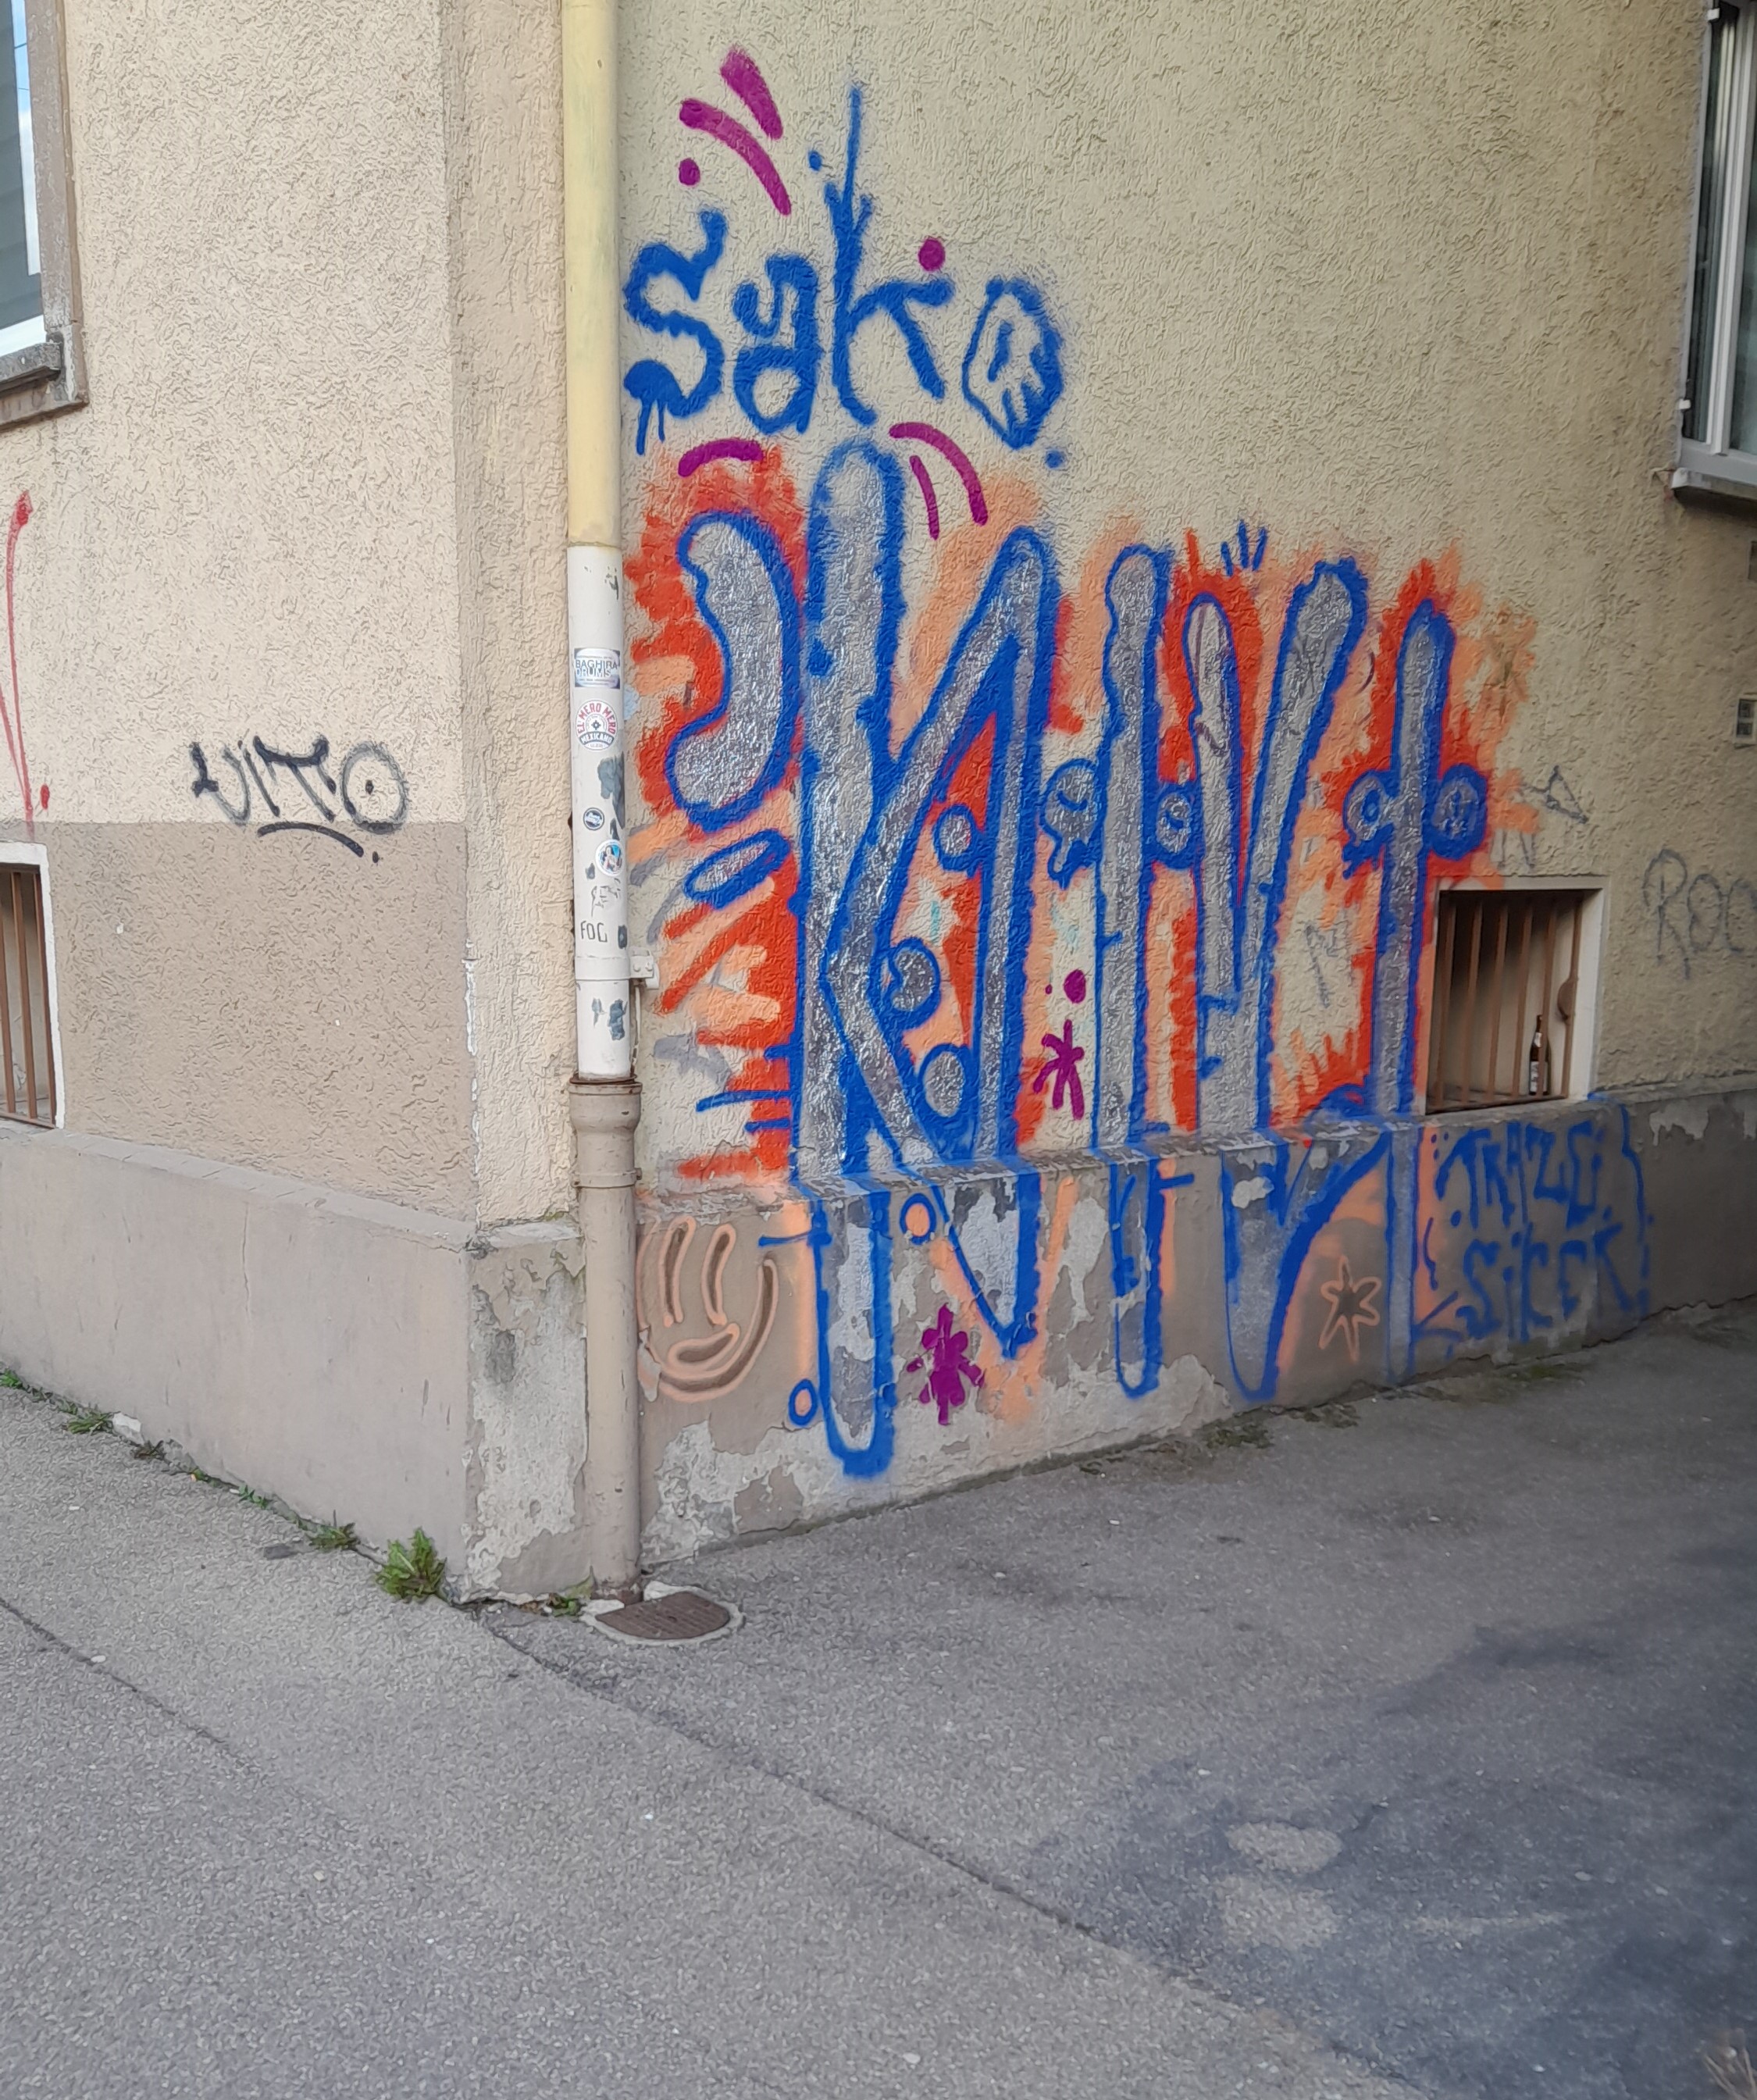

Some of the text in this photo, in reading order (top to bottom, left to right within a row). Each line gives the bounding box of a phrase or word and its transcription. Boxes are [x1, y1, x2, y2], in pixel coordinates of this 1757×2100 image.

[576, 659, 618, 669] BAGHIRA
[576, 667, 611, 678] DRUMS
[579, 702, 602, 720] MERO
[601, 706, 616, 735] MERO
[577, 722, 586, 734] EL
